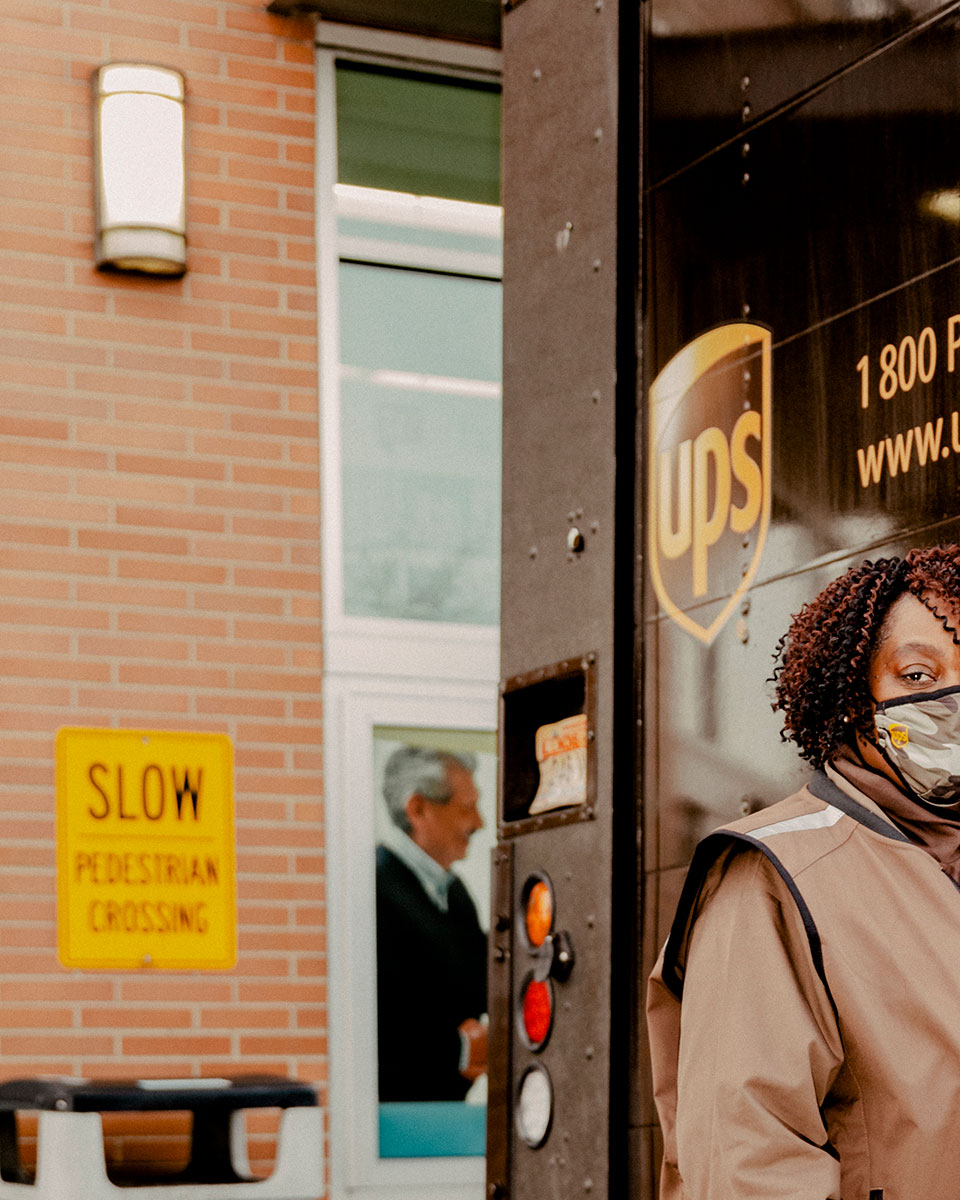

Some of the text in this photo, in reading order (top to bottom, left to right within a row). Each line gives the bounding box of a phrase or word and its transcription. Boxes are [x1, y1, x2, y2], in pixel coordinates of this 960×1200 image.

[856, 355, 869, 409] 1
[879, 327, 937, 400] 800
[659, 410, 762, 597] ups
[88, 762, 204, 821] SLOW
[75, 852, 219, 886] PEDESTRIAN
[88, 899, 210, 934] CROSSING
